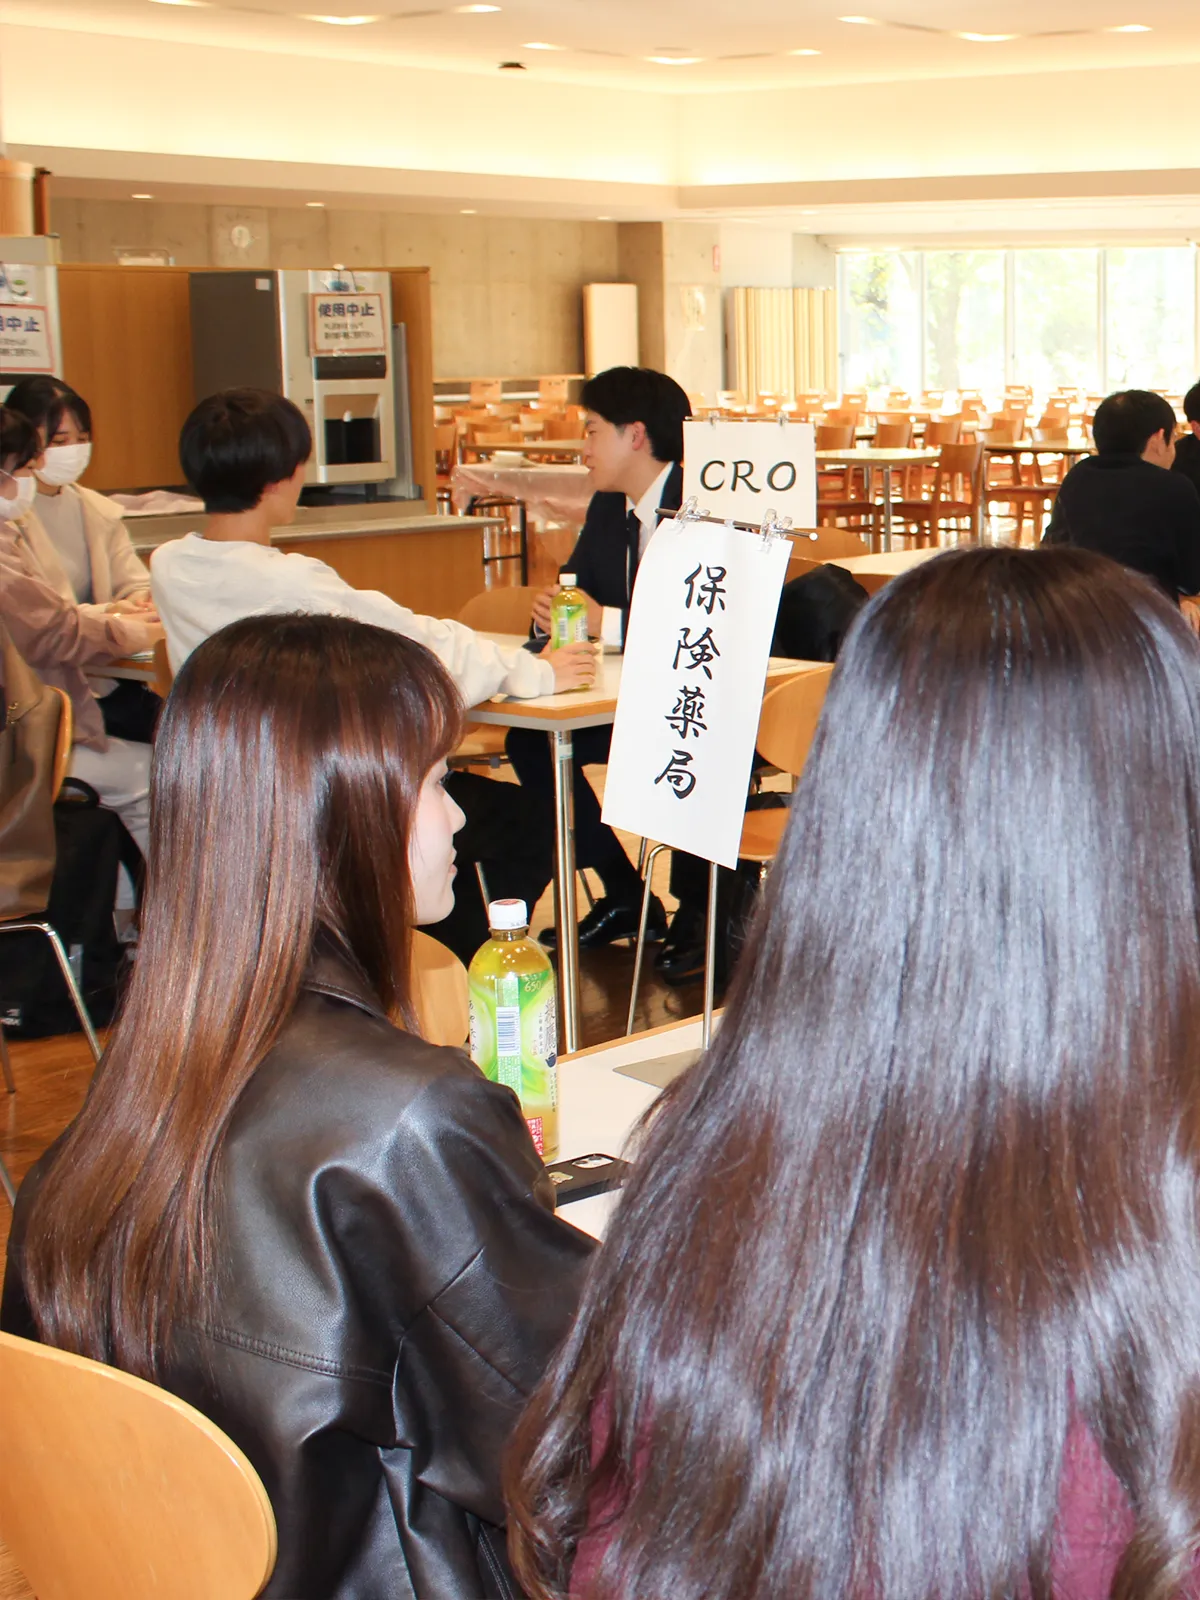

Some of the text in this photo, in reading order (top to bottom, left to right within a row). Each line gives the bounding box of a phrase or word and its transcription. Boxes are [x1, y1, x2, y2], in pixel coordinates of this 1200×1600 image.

[318, 302, 375, 318] 使用中止
[0, 315, 41, 332] 中止
[700, 459, 797, 493] CRO
[653, 561, 729, 801] 保険薬局
[524, 980, 541, 993] 650
